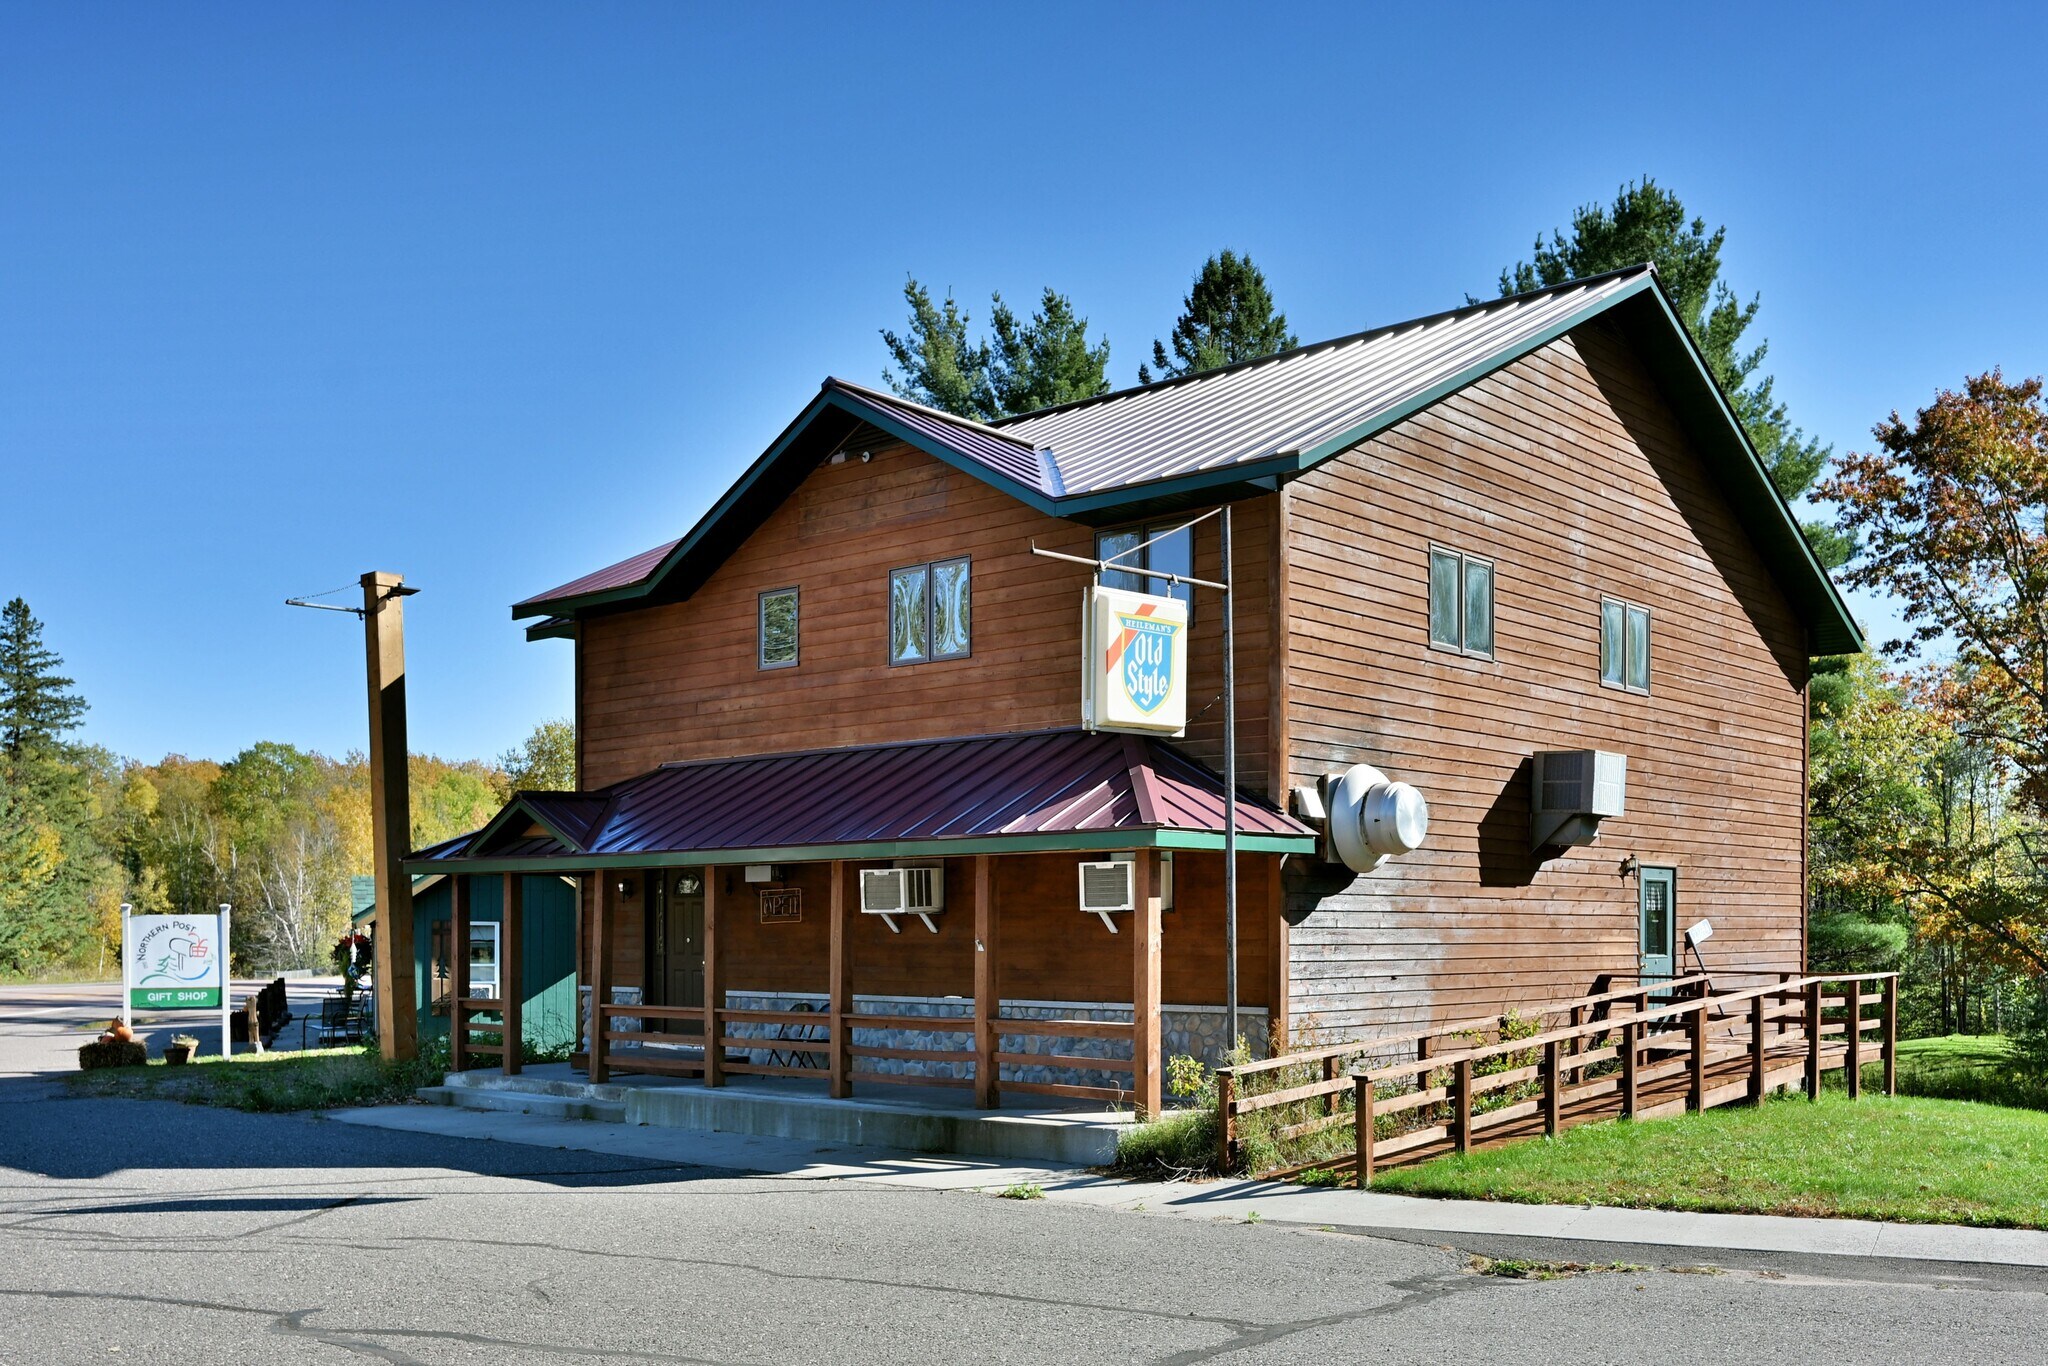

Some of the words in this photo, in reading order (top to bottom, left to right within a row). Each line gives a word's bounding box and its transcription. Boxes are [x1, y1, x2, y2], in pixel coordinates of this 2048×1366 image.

[1125, 619, 1172, 633] HEILEMAN'S
[1134, 633, 1163, 666] Old
[1127, 660, 1168, 706] Style
[136, 923, 169, 963] NORTHERN
[172, 920, 197, 933] POST
[147, 992, 172, 1002] GIFT
[177, 991, 208, 1001] SHOP
